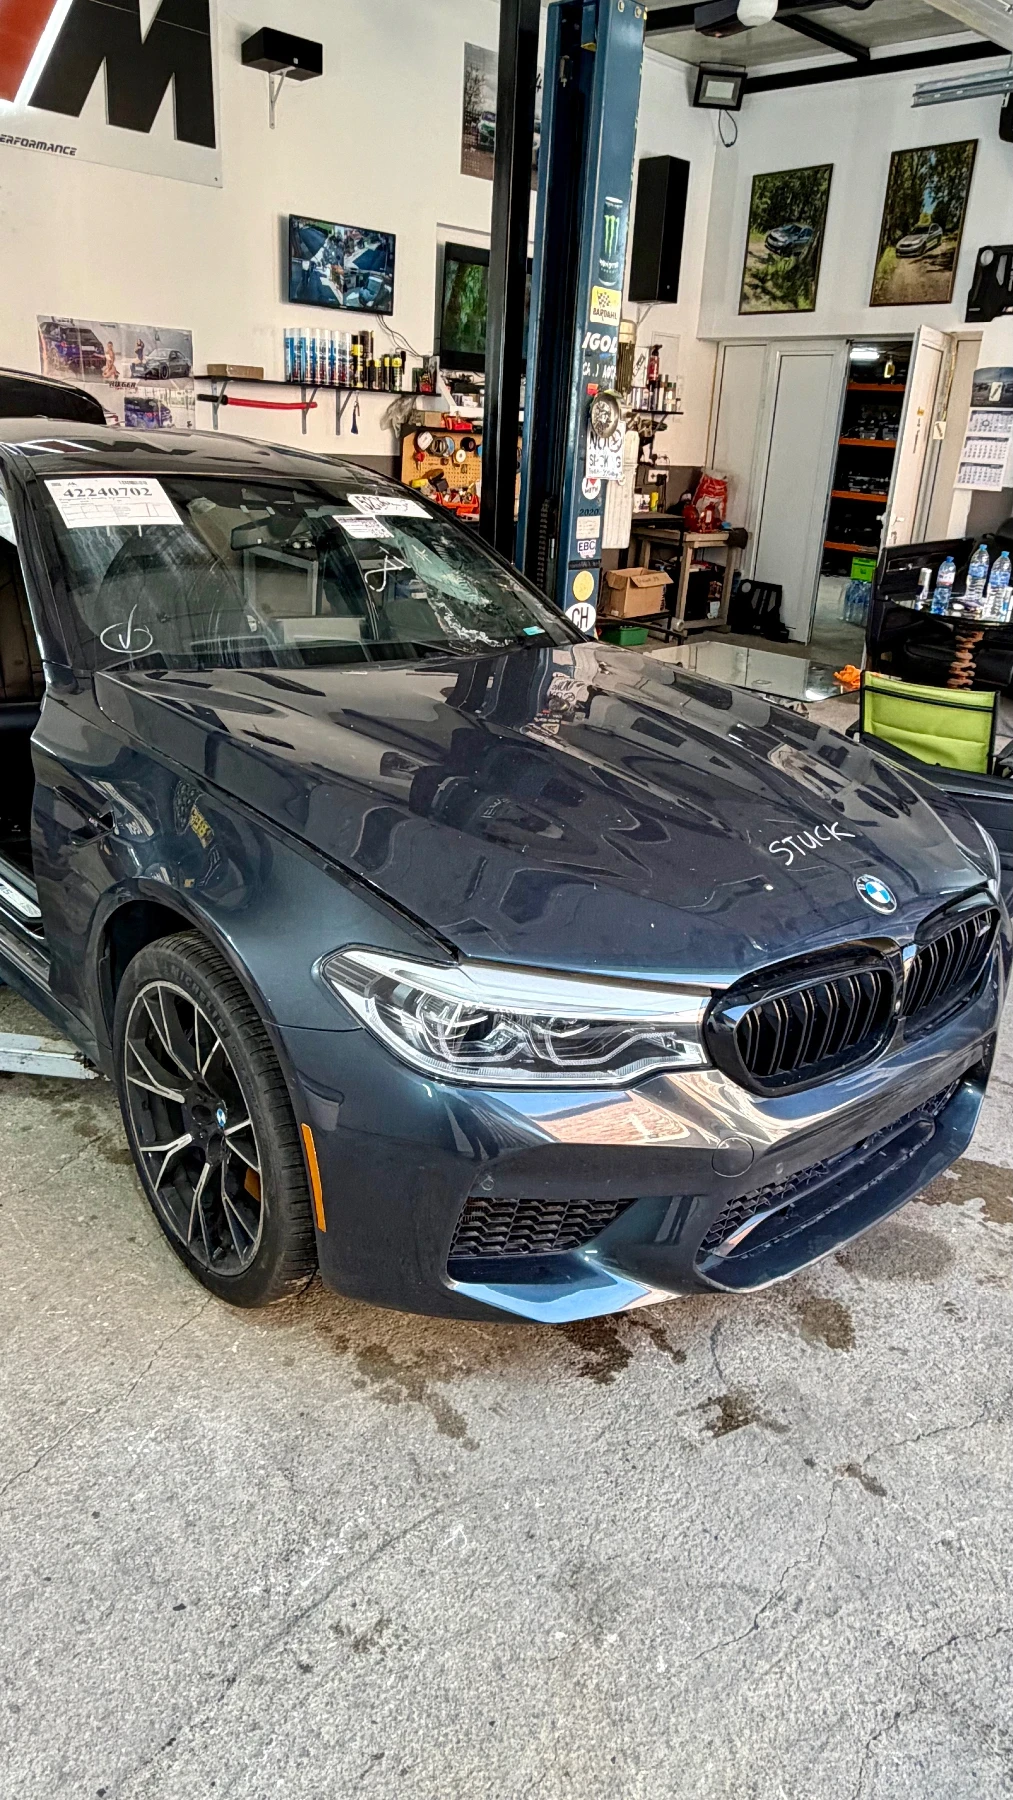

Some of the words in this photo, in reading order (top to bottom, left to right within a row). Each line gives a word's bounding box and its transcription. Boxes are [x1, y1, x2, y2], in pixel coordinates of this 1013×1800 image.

[0, 133, 78, 156] ERFORMANCE
[593, 307, 618, 320] BARDAHL
[581, 332, 618, 354] IGOL
[63, 487, 153, 499] 42240702
[578, 540, 596, 552] EBC
[571, 606, 590, 630] CH
[768, 821, 856, 867] STUCK
[170, 963, 228, 1032] MICHELIN
